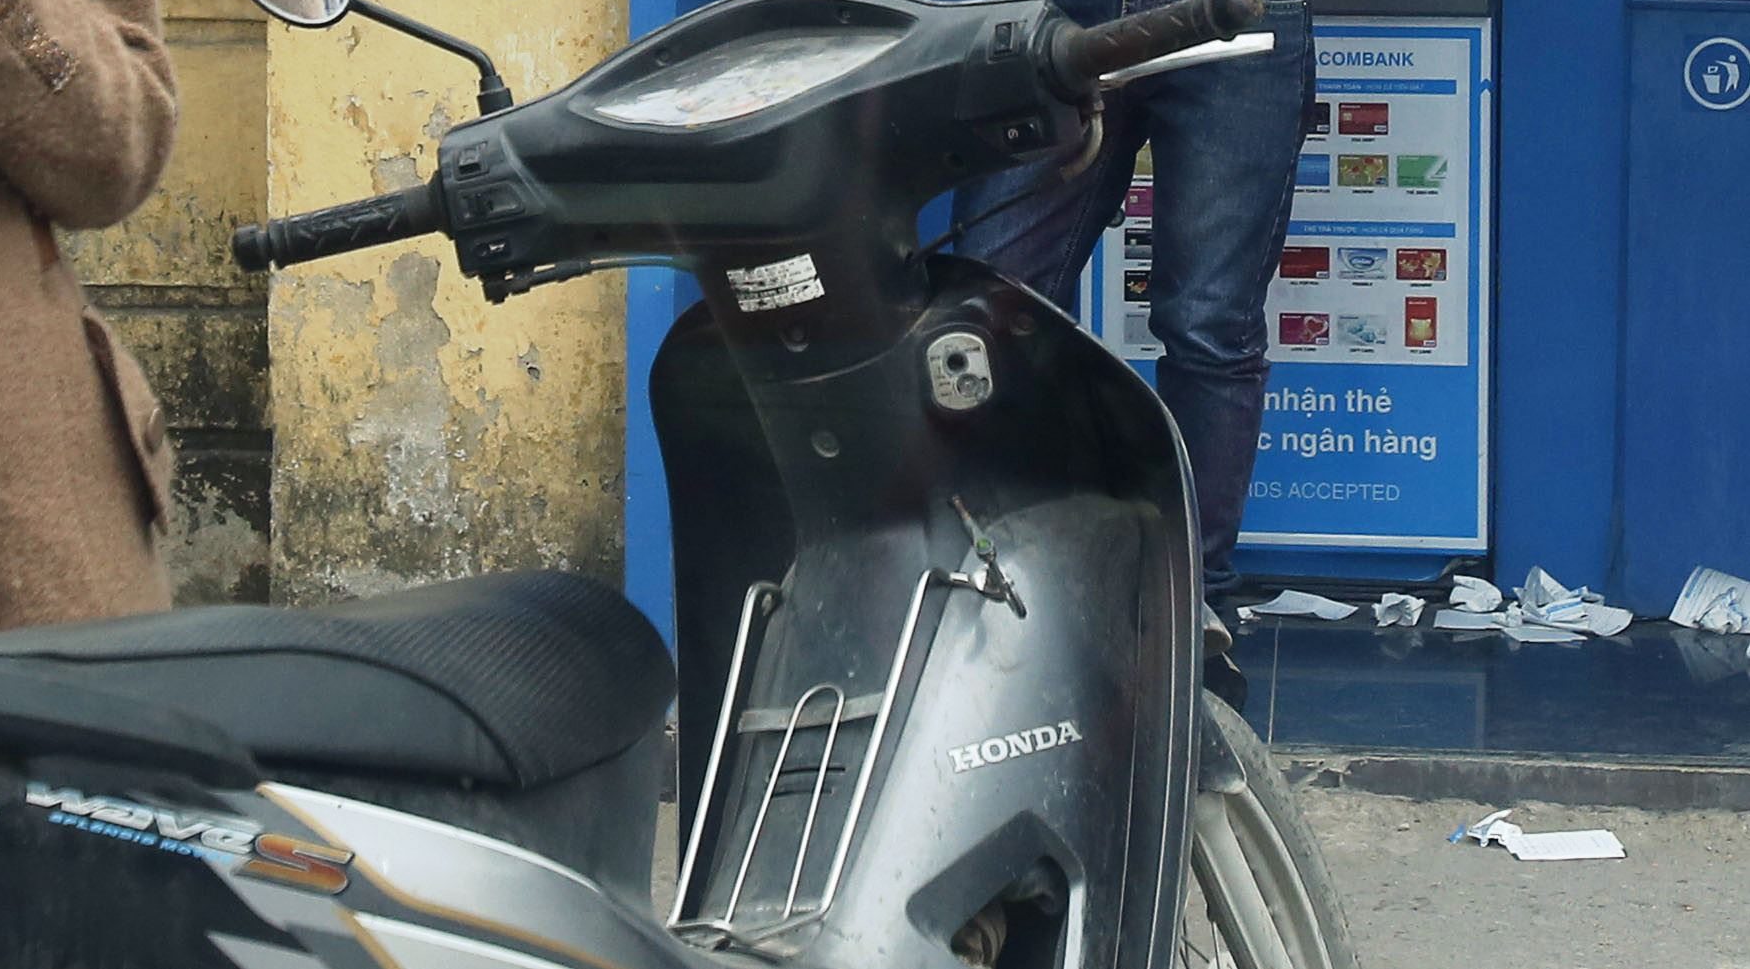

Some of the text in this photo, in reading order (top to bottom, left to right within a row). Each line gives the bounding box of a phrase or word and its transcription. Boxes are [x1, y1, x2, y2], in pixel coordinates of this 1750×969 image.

[1264, 387, 1392, 418] nhận thẻ
[1282, 428, 1354, 458] ngân
[1364, 429, 1437, 461] hàng
[1288, 482, 1401, 501] ACCEPTED
[948, 720, 1083, 774] HONDA
